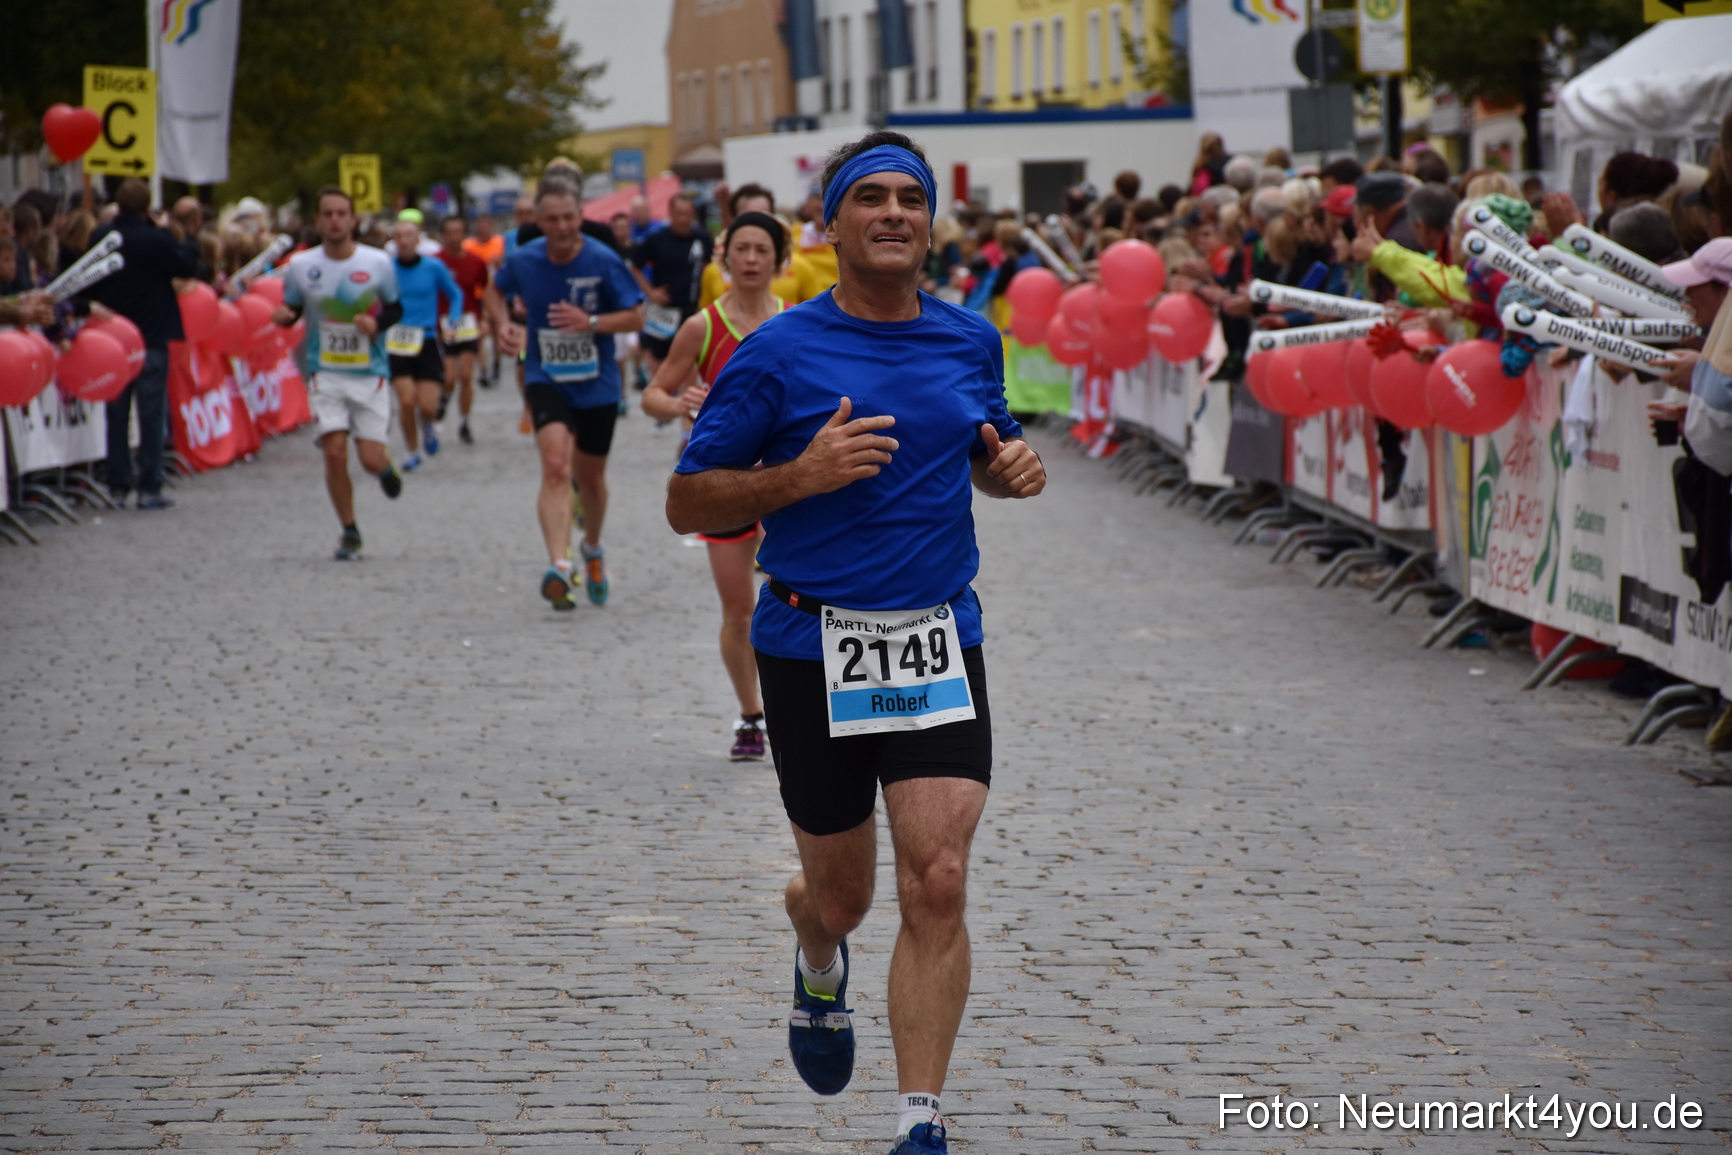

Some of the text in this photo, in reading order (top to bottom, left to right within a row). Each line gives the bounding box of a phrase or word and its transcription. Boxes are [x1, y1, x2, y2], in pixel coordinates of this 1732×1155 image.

[92, 72, 147, 93] Block
[103, 100, 137, 151] C
[1492, 252, 1533, 282] BMW
[328, 334, 359, 352] 238
[1284, 330, 1321, 346] BMW
[545, 341, 592, 361] 3059
[826, 614, 932, 635] PARTL Neumarkt
[838, 627, 949, 683] 2149
[833, 681, 839, 690] B
[871, 692, 930, 713] Robert
[908, 1097, 928, 1107] TECH
